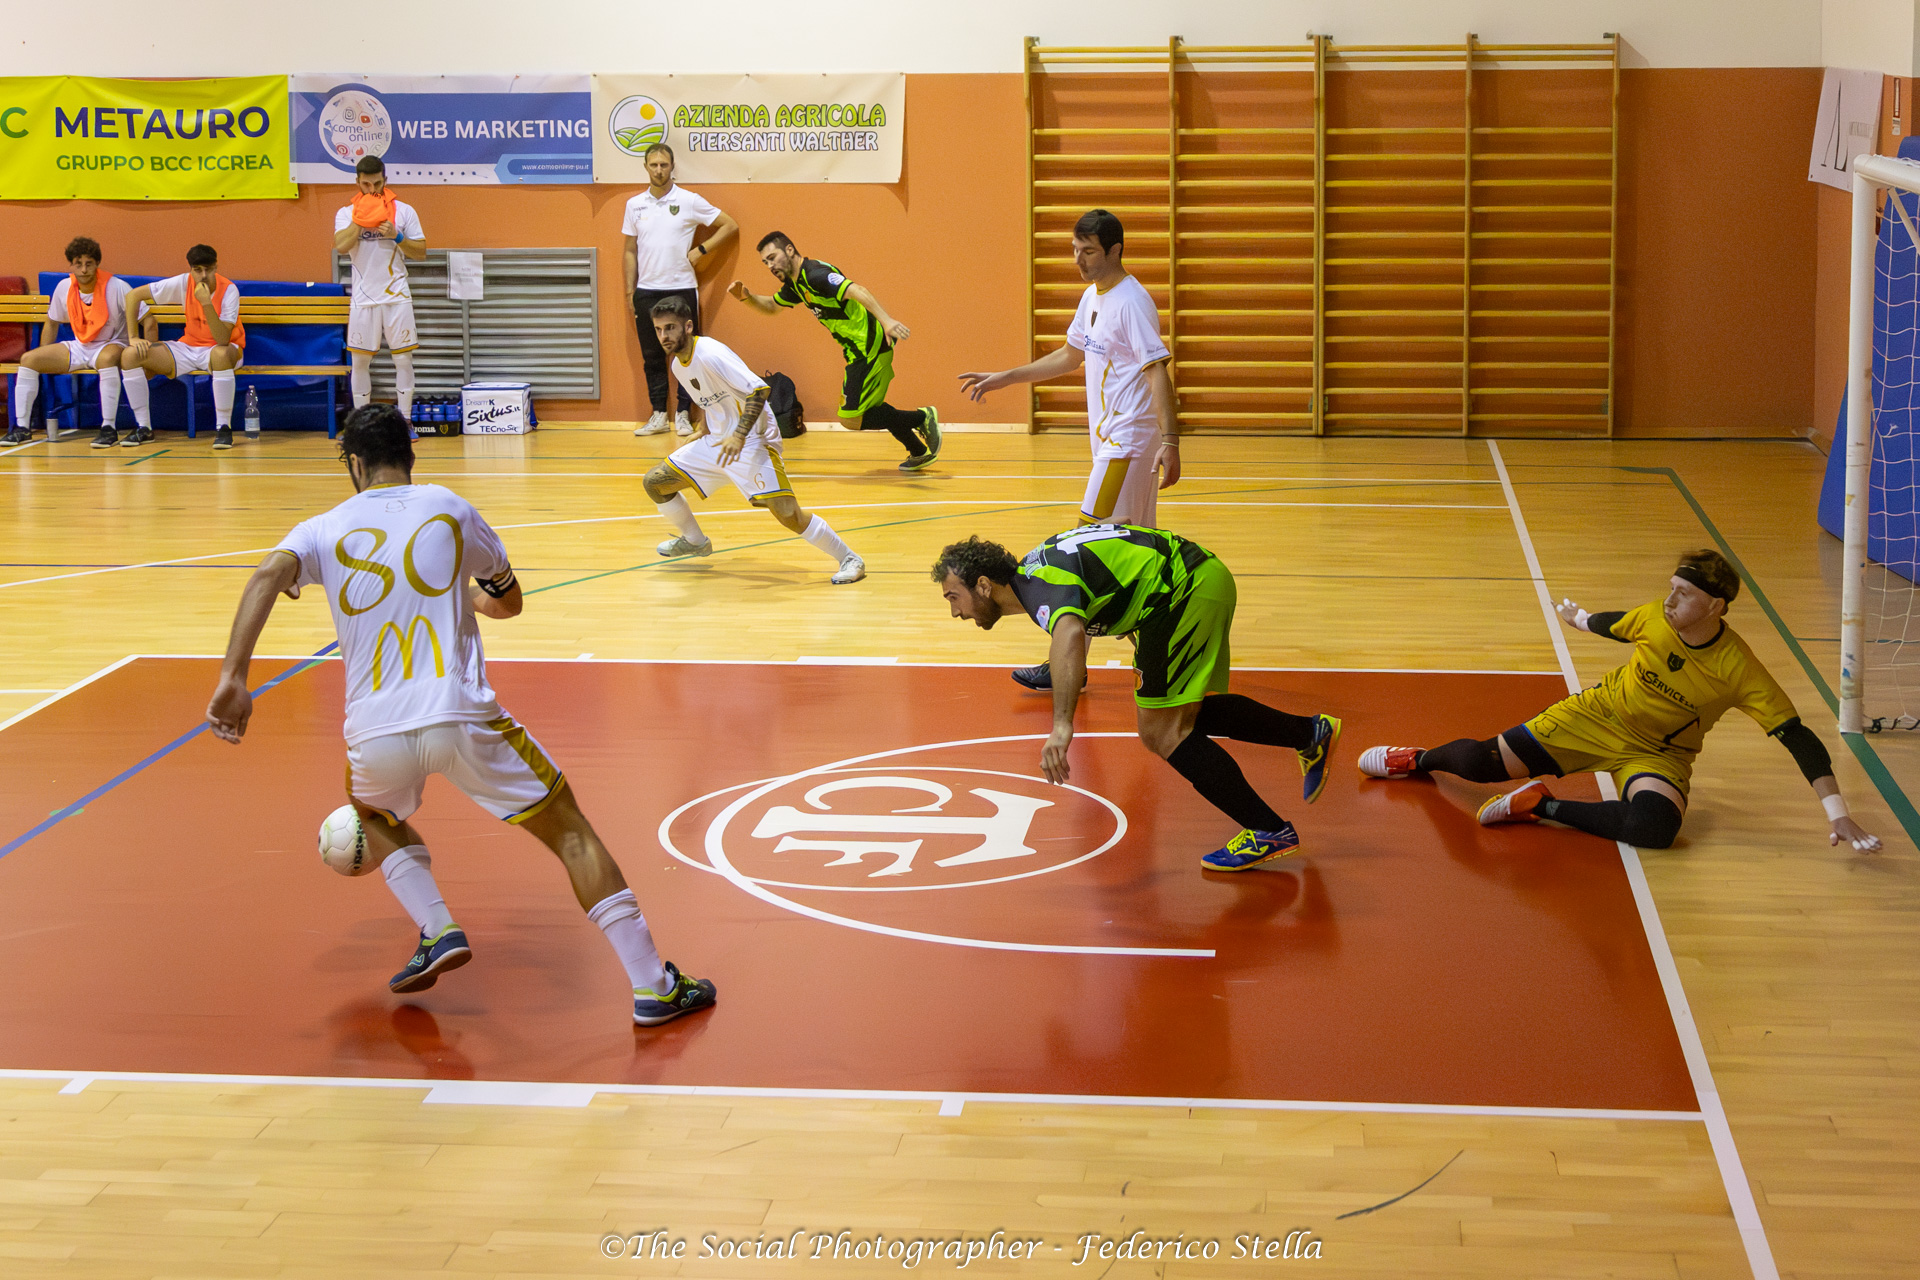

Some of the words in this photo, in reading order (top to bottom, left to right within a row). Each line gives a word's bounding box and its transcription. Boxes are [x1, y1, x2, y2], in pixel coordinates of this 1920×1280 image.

[55, 106, 270, 139] METAURO
[673, 104, 770, 128] AZIENDA
[775, 103, 886, 127] AGRICOLA
[333, 124, 363, 133] come
[349, 131, 383, 142] online
[397, 120, 448, 138] WEB
[455, 119, 590, 139] MARKETING
[688, 131, 785, 152] PIERSANTI
[790, 131, 878, 152] WALTHER
[56, 154, 145, 171] GRUPPO
[150, 155, 192, 171] BCC
[198, 154, 274, 171] ICCREA
[401, 329, 411, 344] 2
[754, 473, 766, 490] 6
[335, 513, 464, 617] 80
